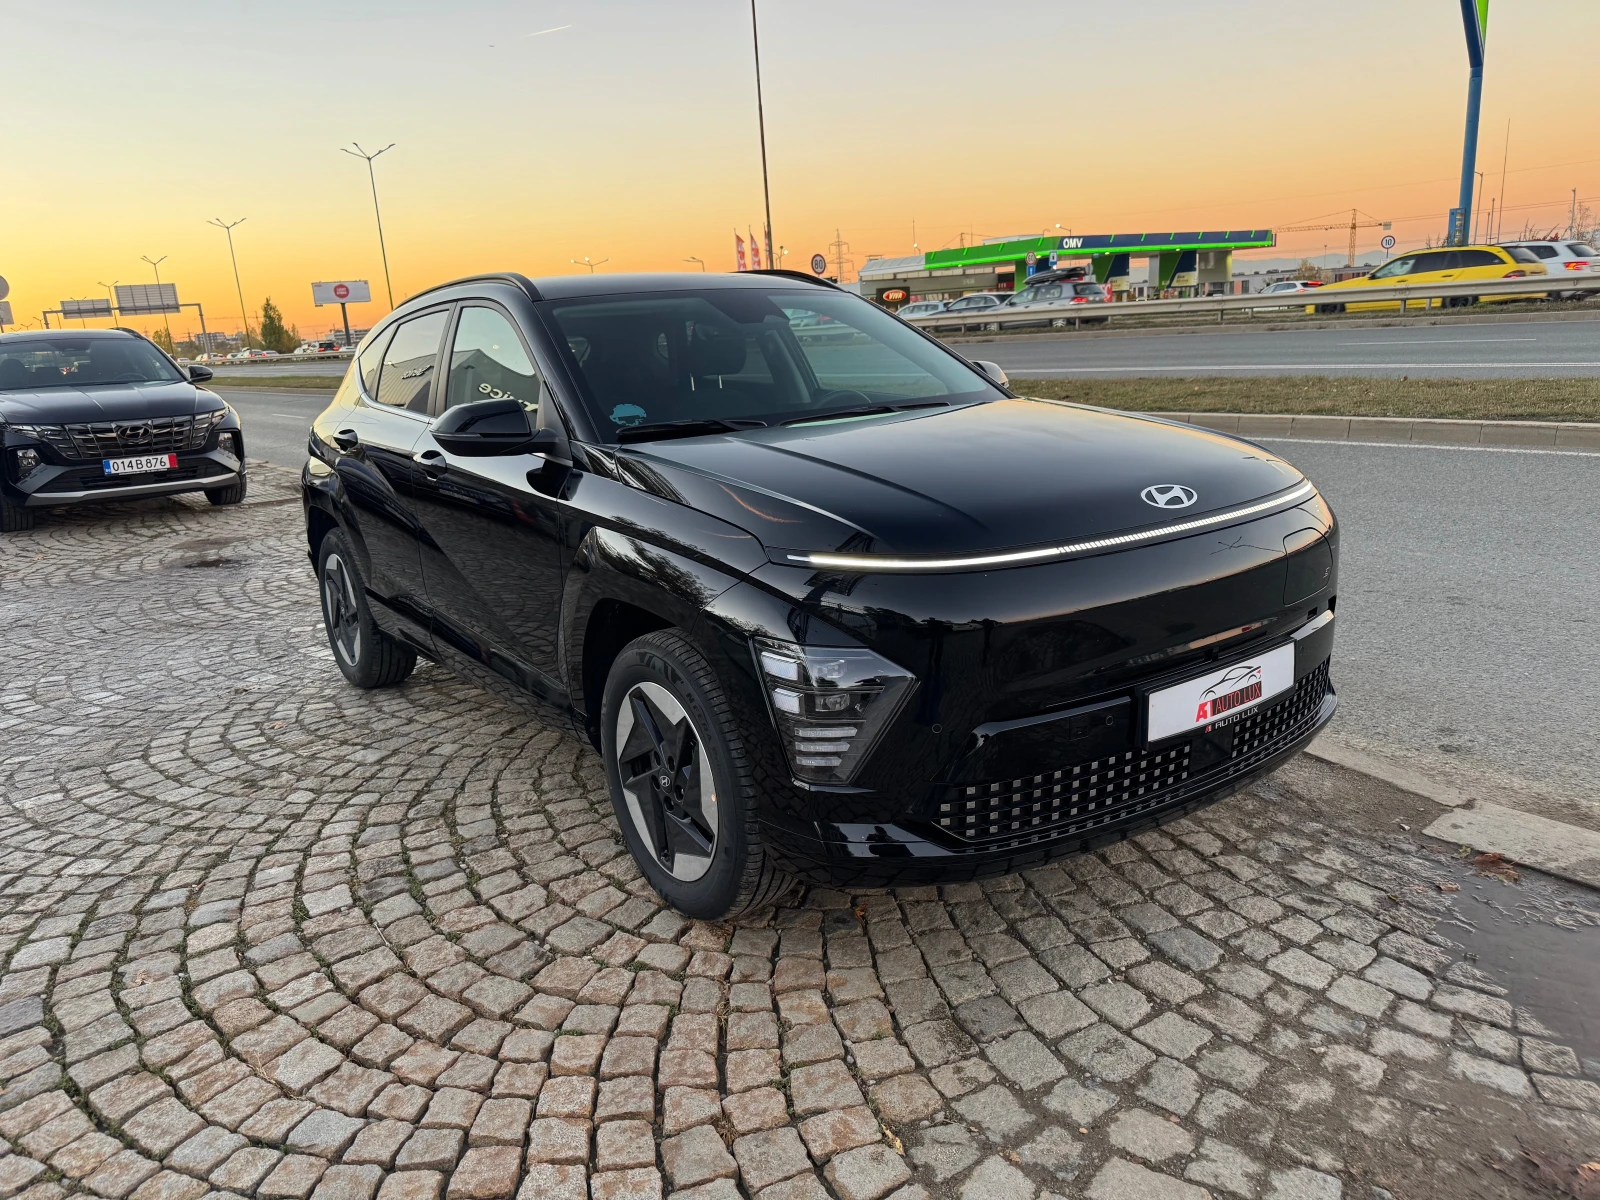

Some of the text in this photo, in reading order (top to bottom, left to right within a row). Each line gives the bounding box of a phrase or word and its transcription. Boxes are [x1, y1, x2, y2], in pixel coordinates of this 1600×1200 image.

[1062, 238, 1083, 249] OMV
[1385, 238, 1392, 246] 10
[814, 259, 823, 269] 80
[1195, 683, 1262, 723] A1 AUTO LUX
[1215, 715, 1240, 729] AUTO
[1242, 706, 1259, 719] LUX
